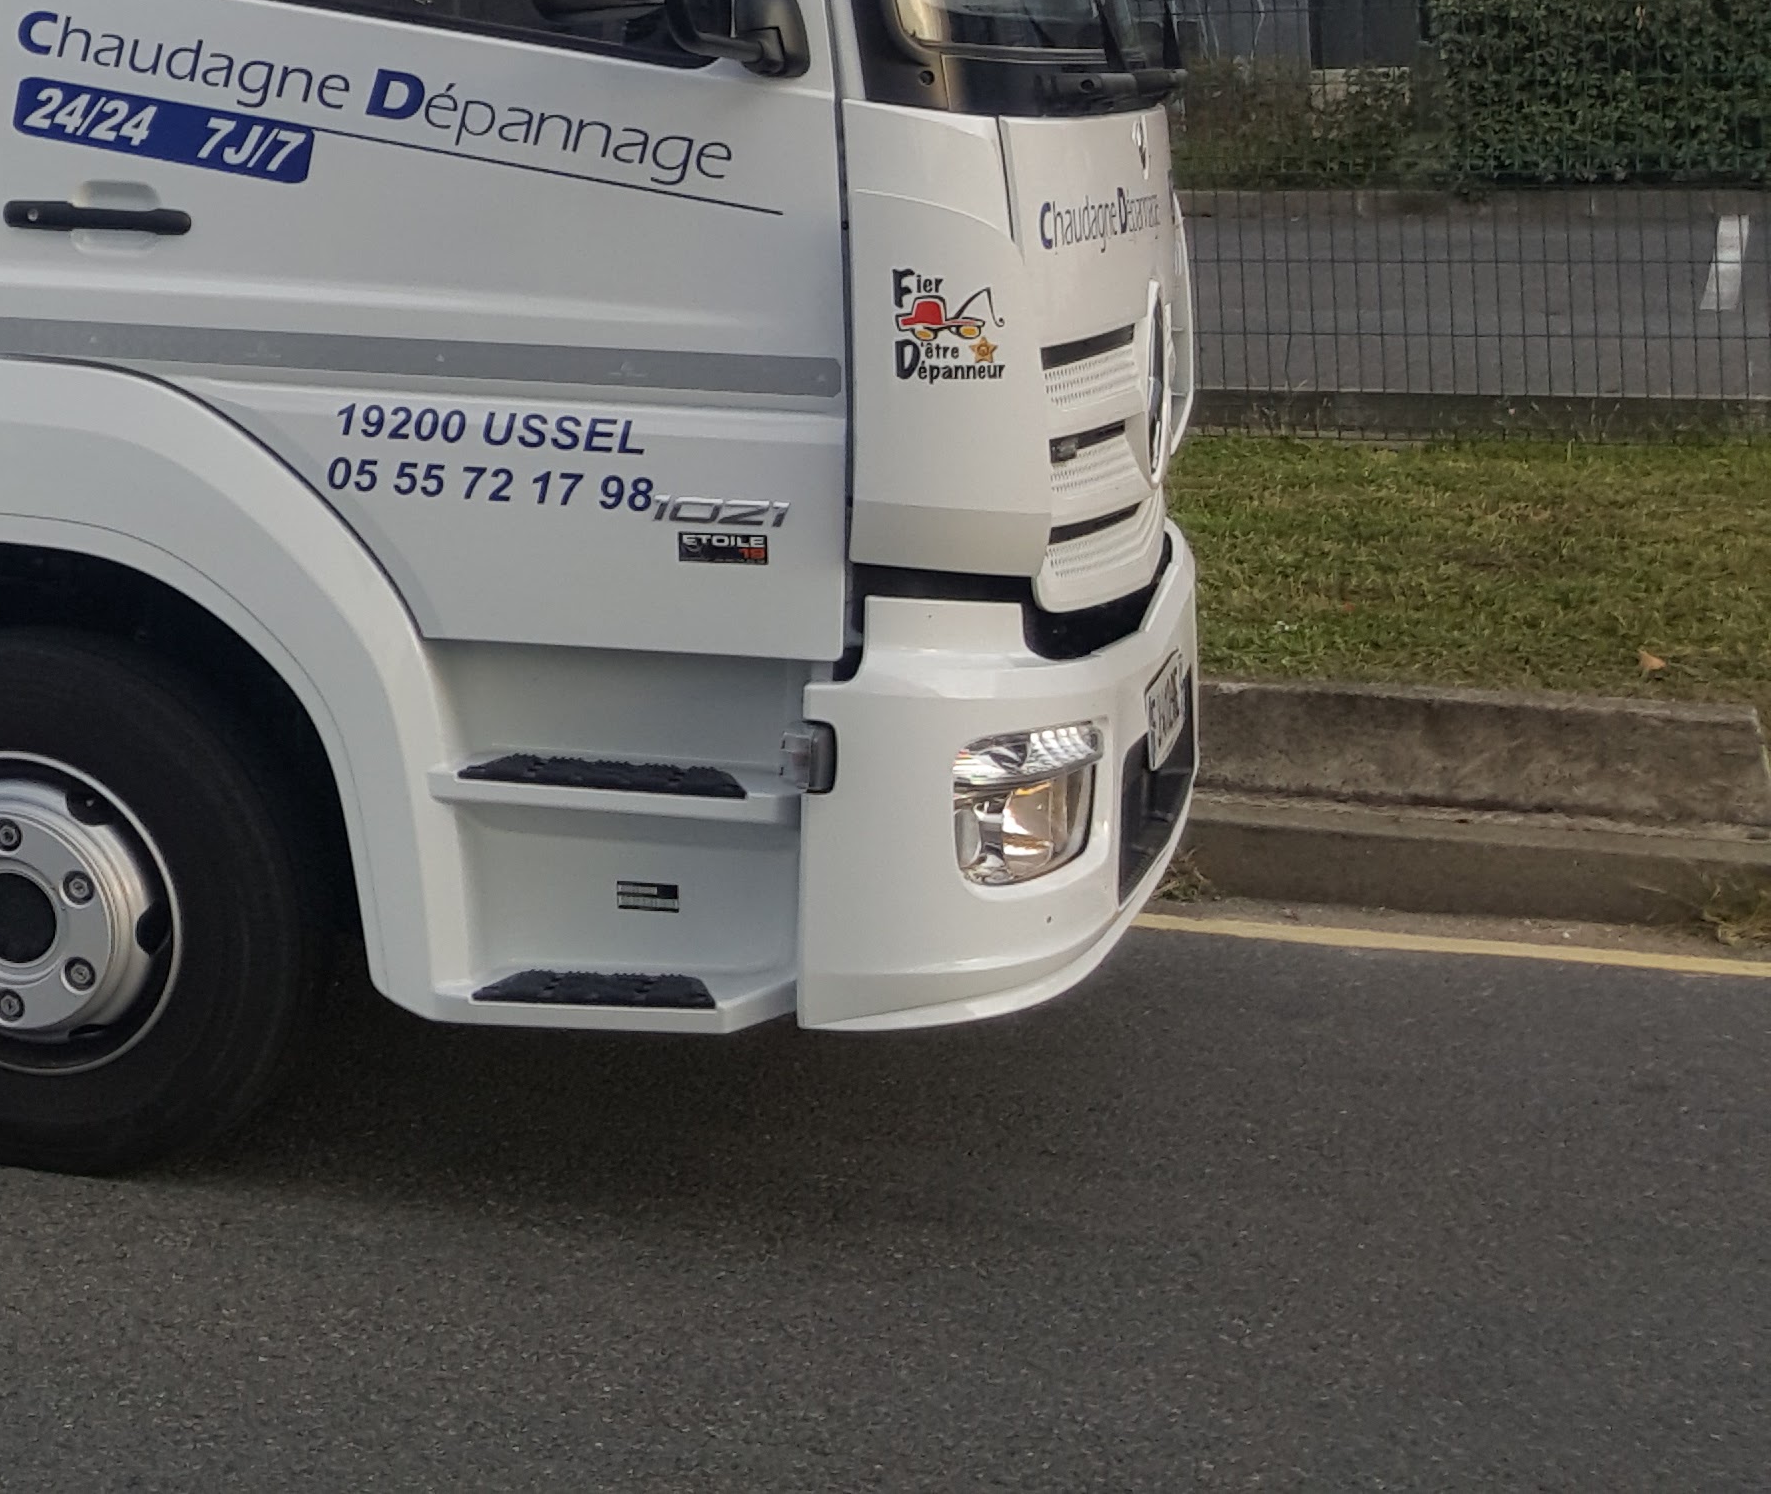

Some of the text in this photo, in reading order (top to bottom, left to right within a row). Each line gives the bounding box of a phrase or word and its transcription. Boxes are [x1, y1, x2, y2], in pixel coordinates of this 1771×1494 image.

[16, 10, 733, 187] Chaudagne Dépannage
[21, 86, 307, 173] 24/24 7J/7
[1039, 194, 1117, 254] Chaudagne
[892, 268, 944, 309] Fier
[335, 403, 646, 456] 19200 USSEL
[326, 456, 654, 512] 05 55 72 17 98
[652, 494, 791, 528] 1021
[681, 534, 765, 548] ETOILE
